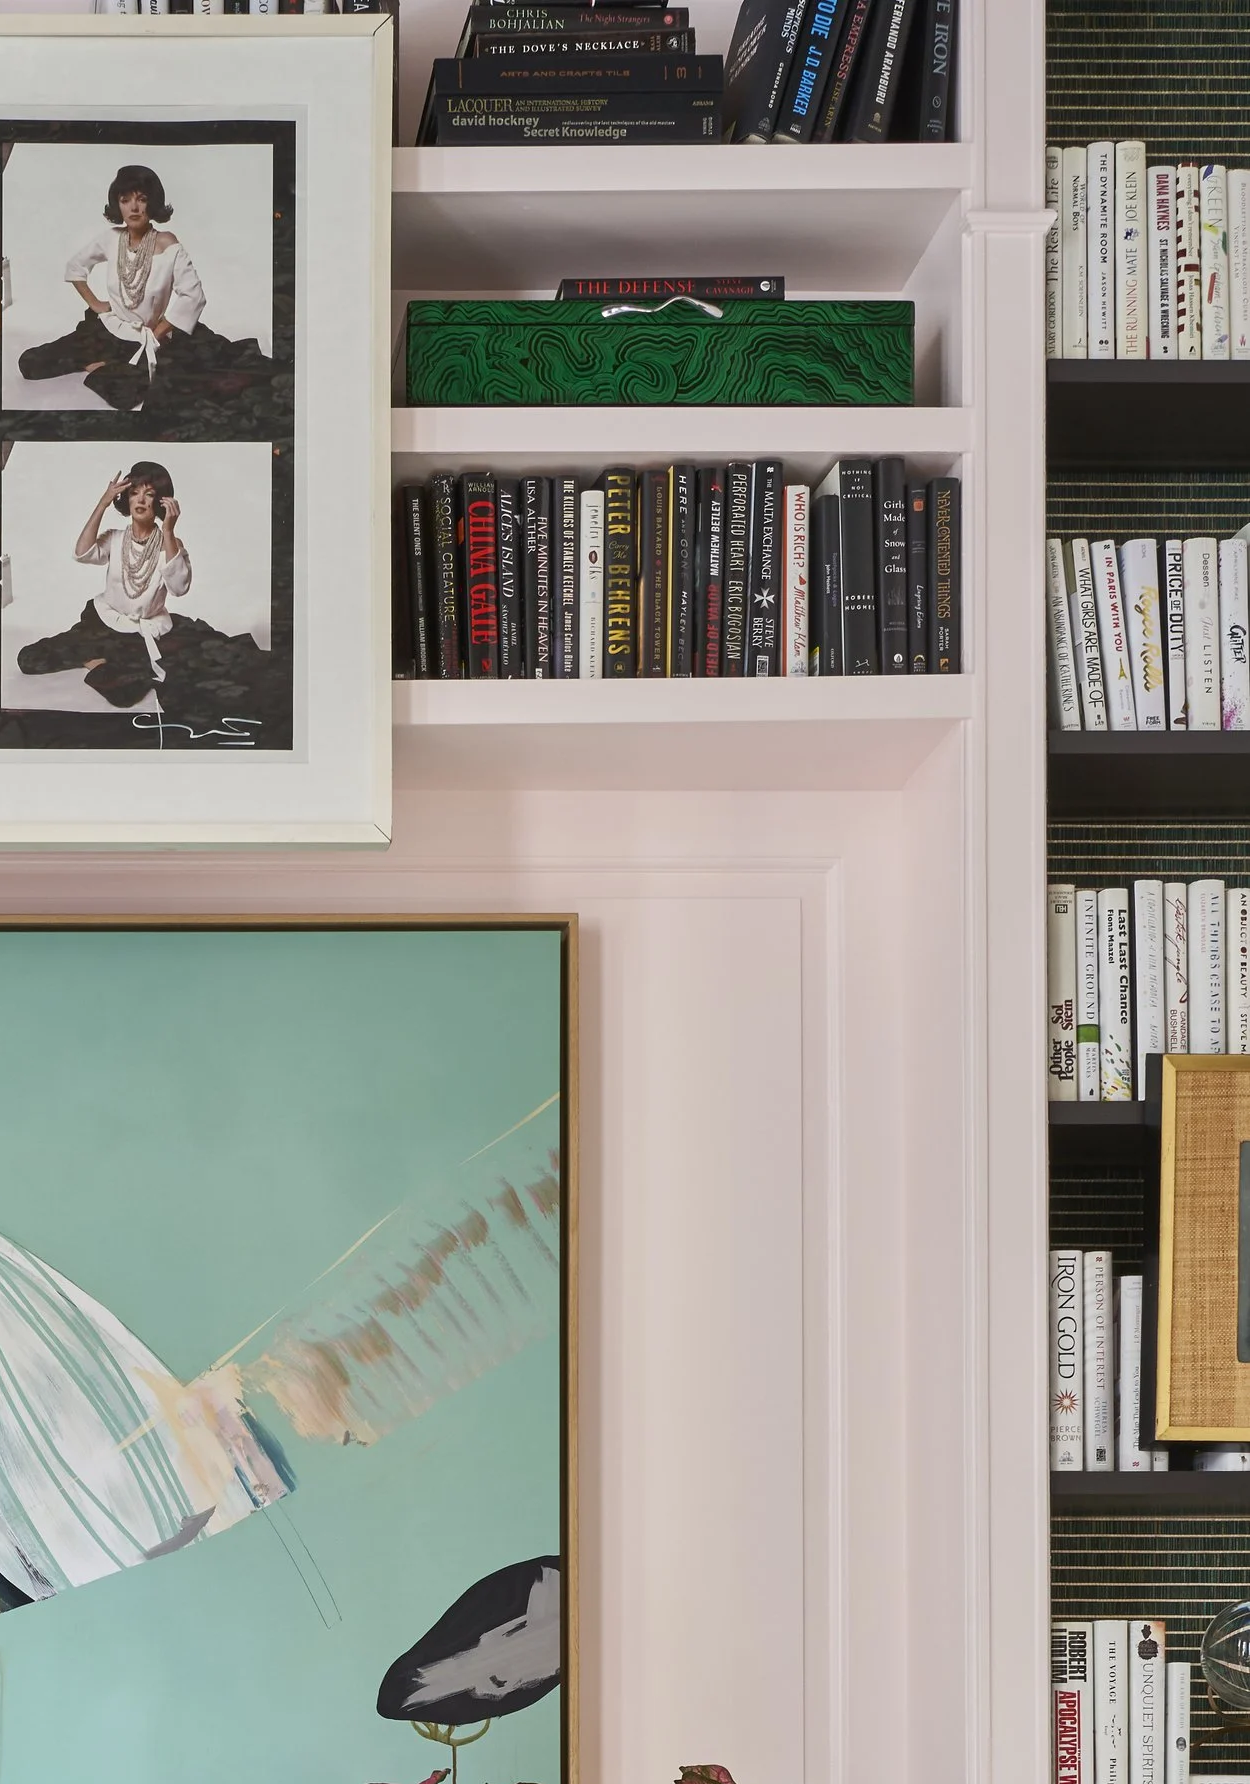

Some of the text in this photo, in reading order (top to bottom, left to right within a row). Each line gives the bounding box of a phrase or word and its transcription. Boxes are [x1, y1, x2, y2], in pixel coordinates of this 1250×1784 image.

[490, 19, 565, 31] BOHJALIAN
[782, 8, 795, 38] MINDS
[933, 23, 949, 76] IRON
[793, 18, 833, 116] DIE J.D. BARKER
[448, 99, 513, 114] LACQUER
[453, 116, 539, 127] david hockney
[524, 127, 627, 139] Secret Knowledge
[1156, 174, 1169, 230] DANA HAYNES
[575, 280, 696, 295] THE DEFENSE
[608, 476, 630, 535] PETER
[793, 492, 805, 568] WHO IS RICH?
[563, 481, 574, 606] THE KILLINGS OF STANLEY KETCHEL
[710, 501, 721, 576] MATTHEW BETLEY
[761, 491, 774, 580] MALTA EXCHANGE
[468, 501, 497, 645] CHINA GATE
[502, 546, 514, 598] ISLAND
[608, 565, 630, 654] BEHRENS
[753, 618, 763, 648] BERRY
[765, 619, 774, 648] STEVE
[1079, 568, 1103, 707] WHAT GIRLS ARE MADE OF
[1118, 909, 1128, 1025] Last Last Chance
[1051, 1257, 1077, 1379] IRON GOLD
[1096, 1268, 1105, 1390] PERSON OF INTEREST
[1069, 1631, 1087, 1682] ROBERT
[1059, 1692, 1078, 1771] APOCALYPSE
